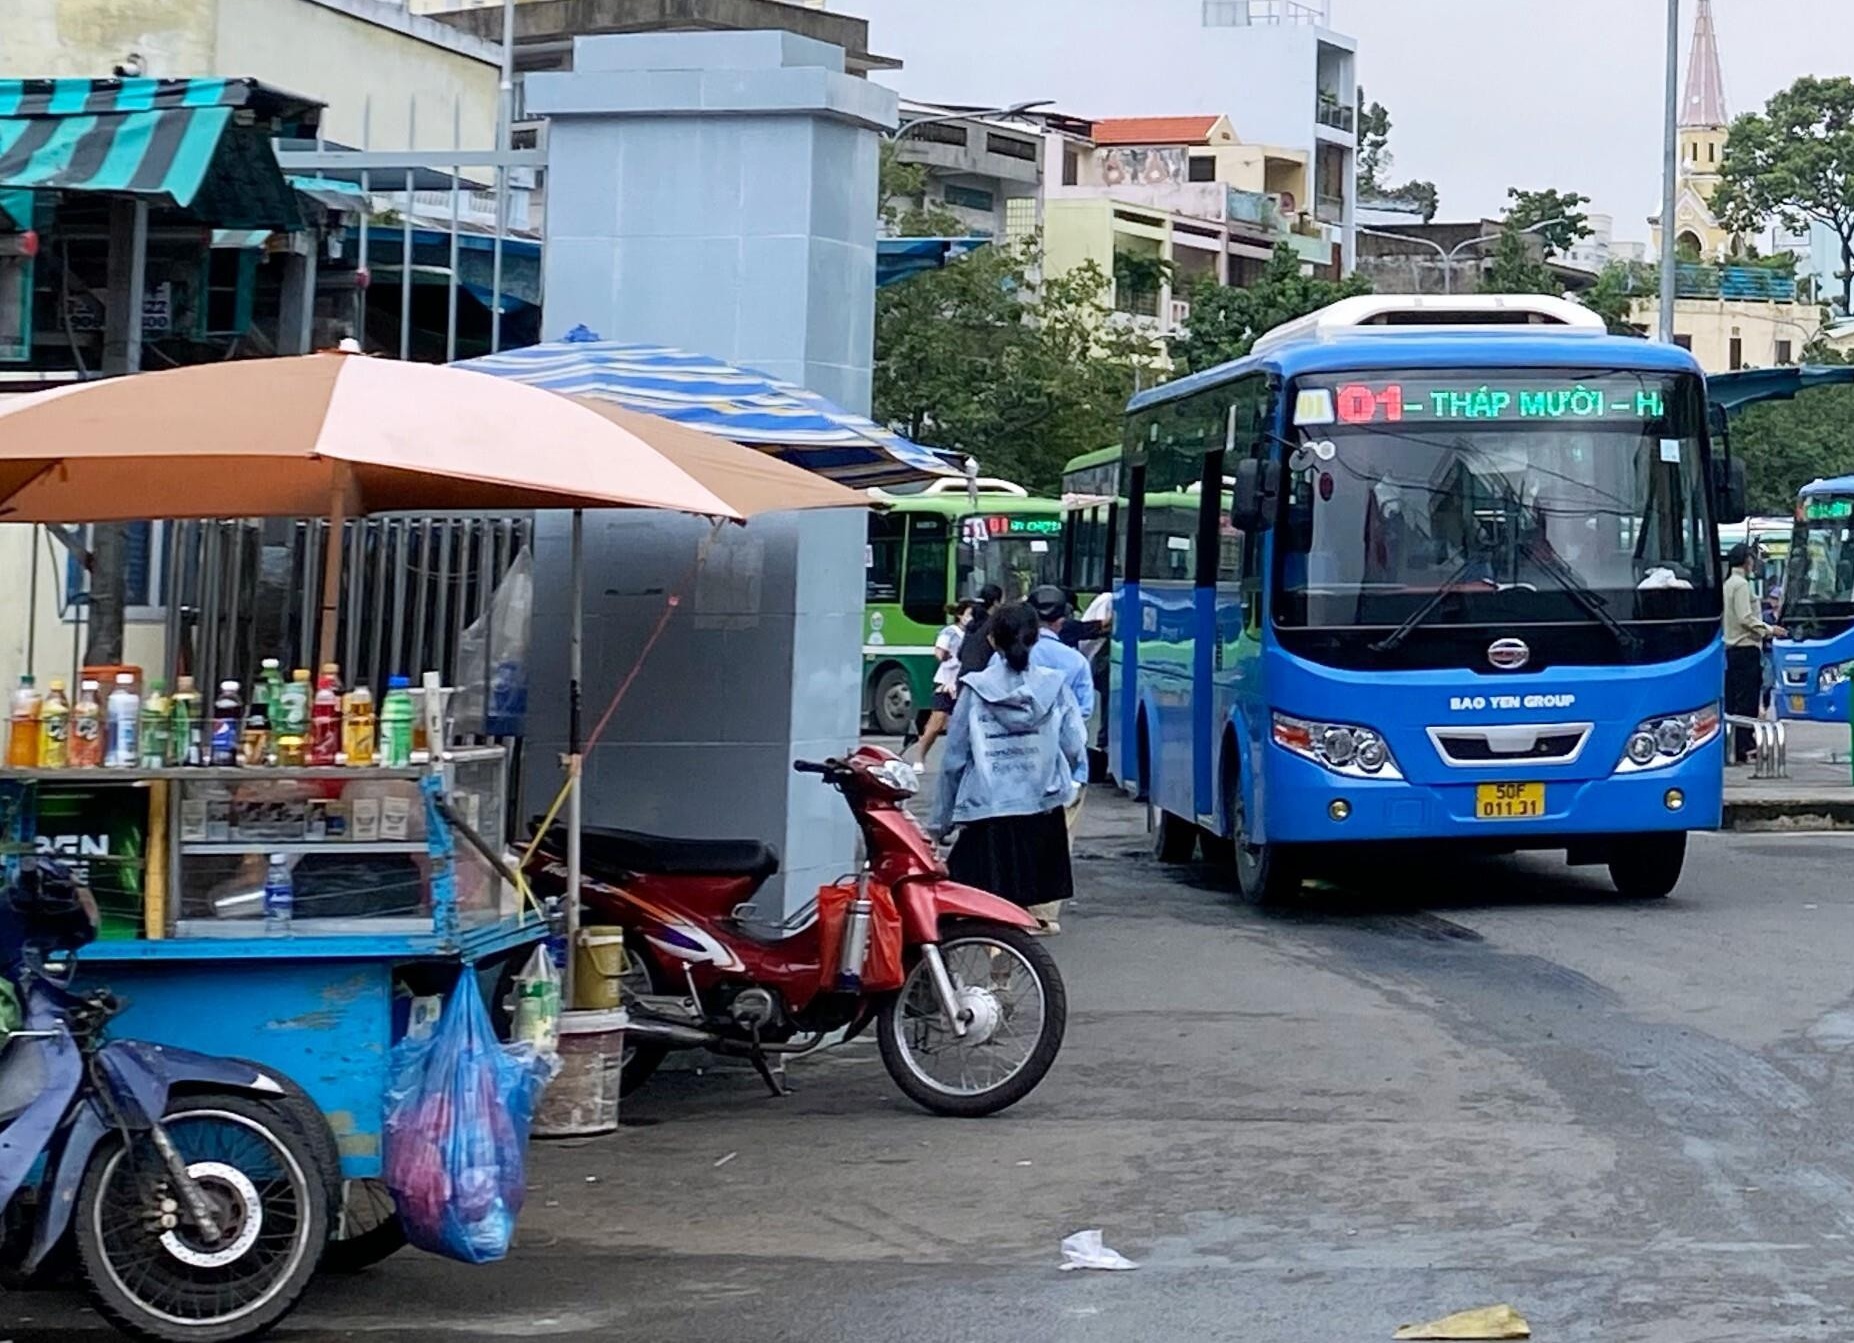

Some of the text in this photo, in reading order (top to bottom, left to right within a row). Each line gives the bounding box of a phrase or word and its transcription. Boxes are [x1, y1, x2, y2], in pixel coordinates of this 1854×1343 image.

[1337, 384, 1402, 424] 01
[1430, 385, 1511, 418] THÁP
[1450, 694, 1575, 710] BAO YEN GROUP
[1496, 784, 1526, 799] 50F
